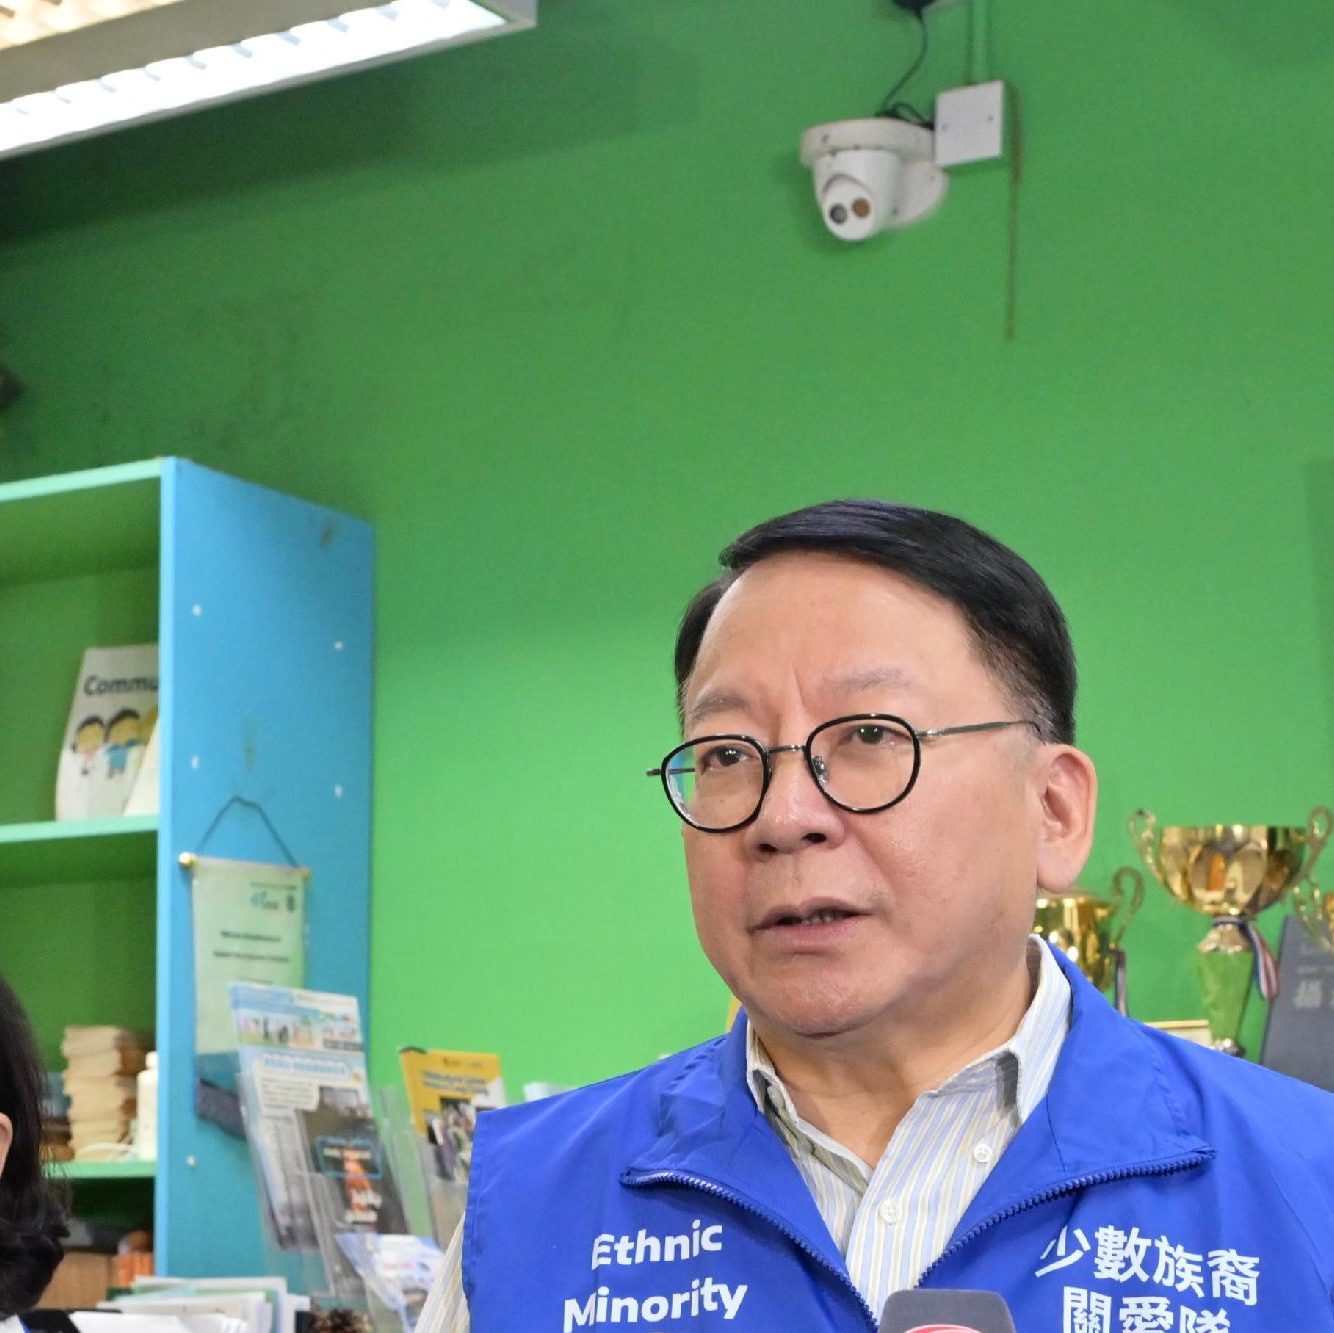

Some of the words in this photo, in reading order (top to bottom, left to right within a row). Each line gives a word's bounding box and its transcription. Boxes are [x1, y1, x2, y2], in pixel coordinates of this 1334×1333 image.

[591, 1219, 723, 1271] Ethnic
[1035, 1225, 1260, 1305] 少數族裔
[563, 1277, 748, 1333] Minority
